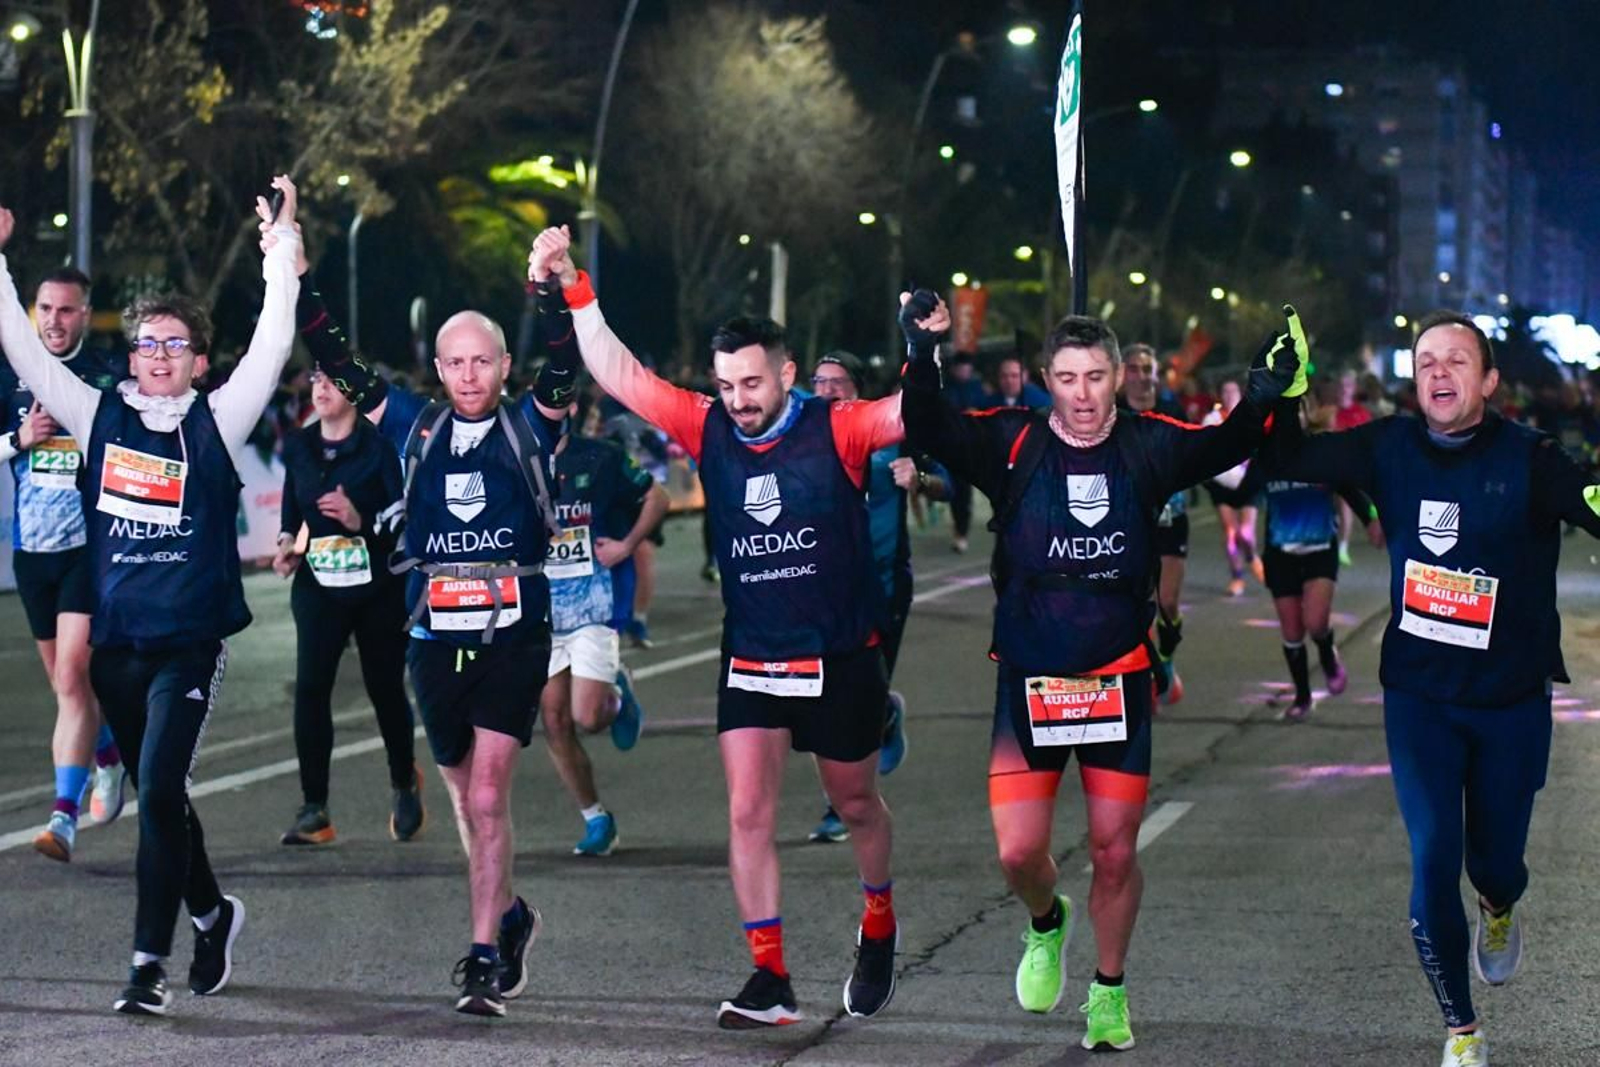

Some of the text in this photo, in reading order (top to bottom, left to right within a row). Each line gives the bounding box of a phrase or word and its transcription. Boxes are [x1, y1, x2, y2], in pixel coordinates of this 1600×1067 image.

[112, 466, 170, 487] AUXILIAR
[109, 516, 193, 540] MEDAC
[426, 527, 514, 554] MEDAC
[731, 527, 817, 558] MEDAC
[1048, 531, 1126, 560] MEDAC
[309, 549, 363, 568] 2214
[458, 594, 487, 606] RCP
[1414, 583, 1479, 606] AUXILIAR
[1428, 601, 1457, 617] RCP
[763, 662, 789, 672] RCP
[1043, 691, 1108, 705] AUXILIAR
[1061, 707, 1090, 719] RCP
